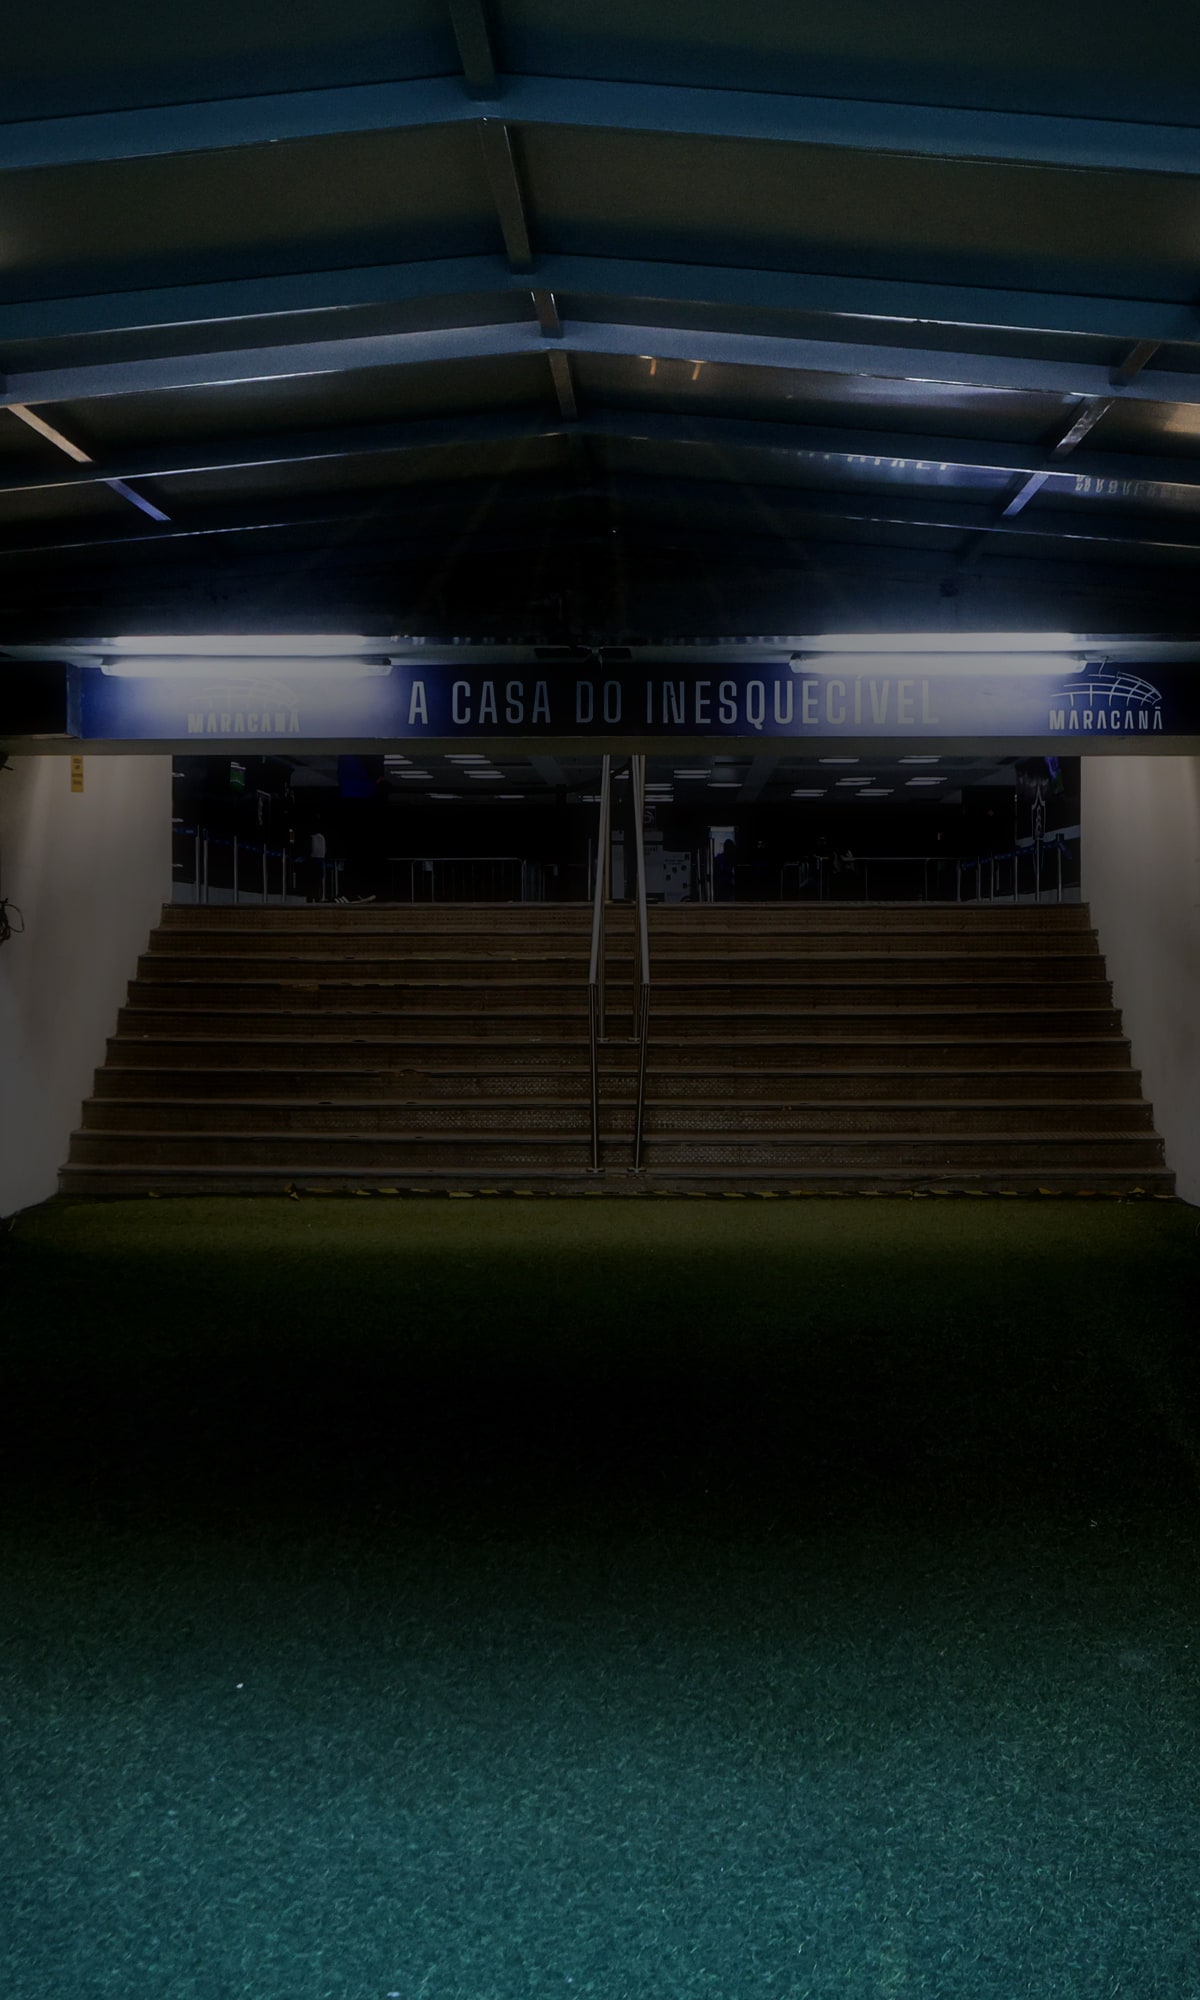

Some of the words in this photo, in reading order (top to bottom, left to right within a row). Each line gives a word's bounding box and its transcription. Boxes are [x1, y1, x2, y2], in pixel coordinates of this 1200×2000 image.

[407, 680, 429, 725] A
[451, 680, 551, 725] CASA
[575, 680, 622, 724] DO
[645, 675, 940, 730] INESQUECÍVEL
[1049, 706, 1163, 730] MARACANÃ
